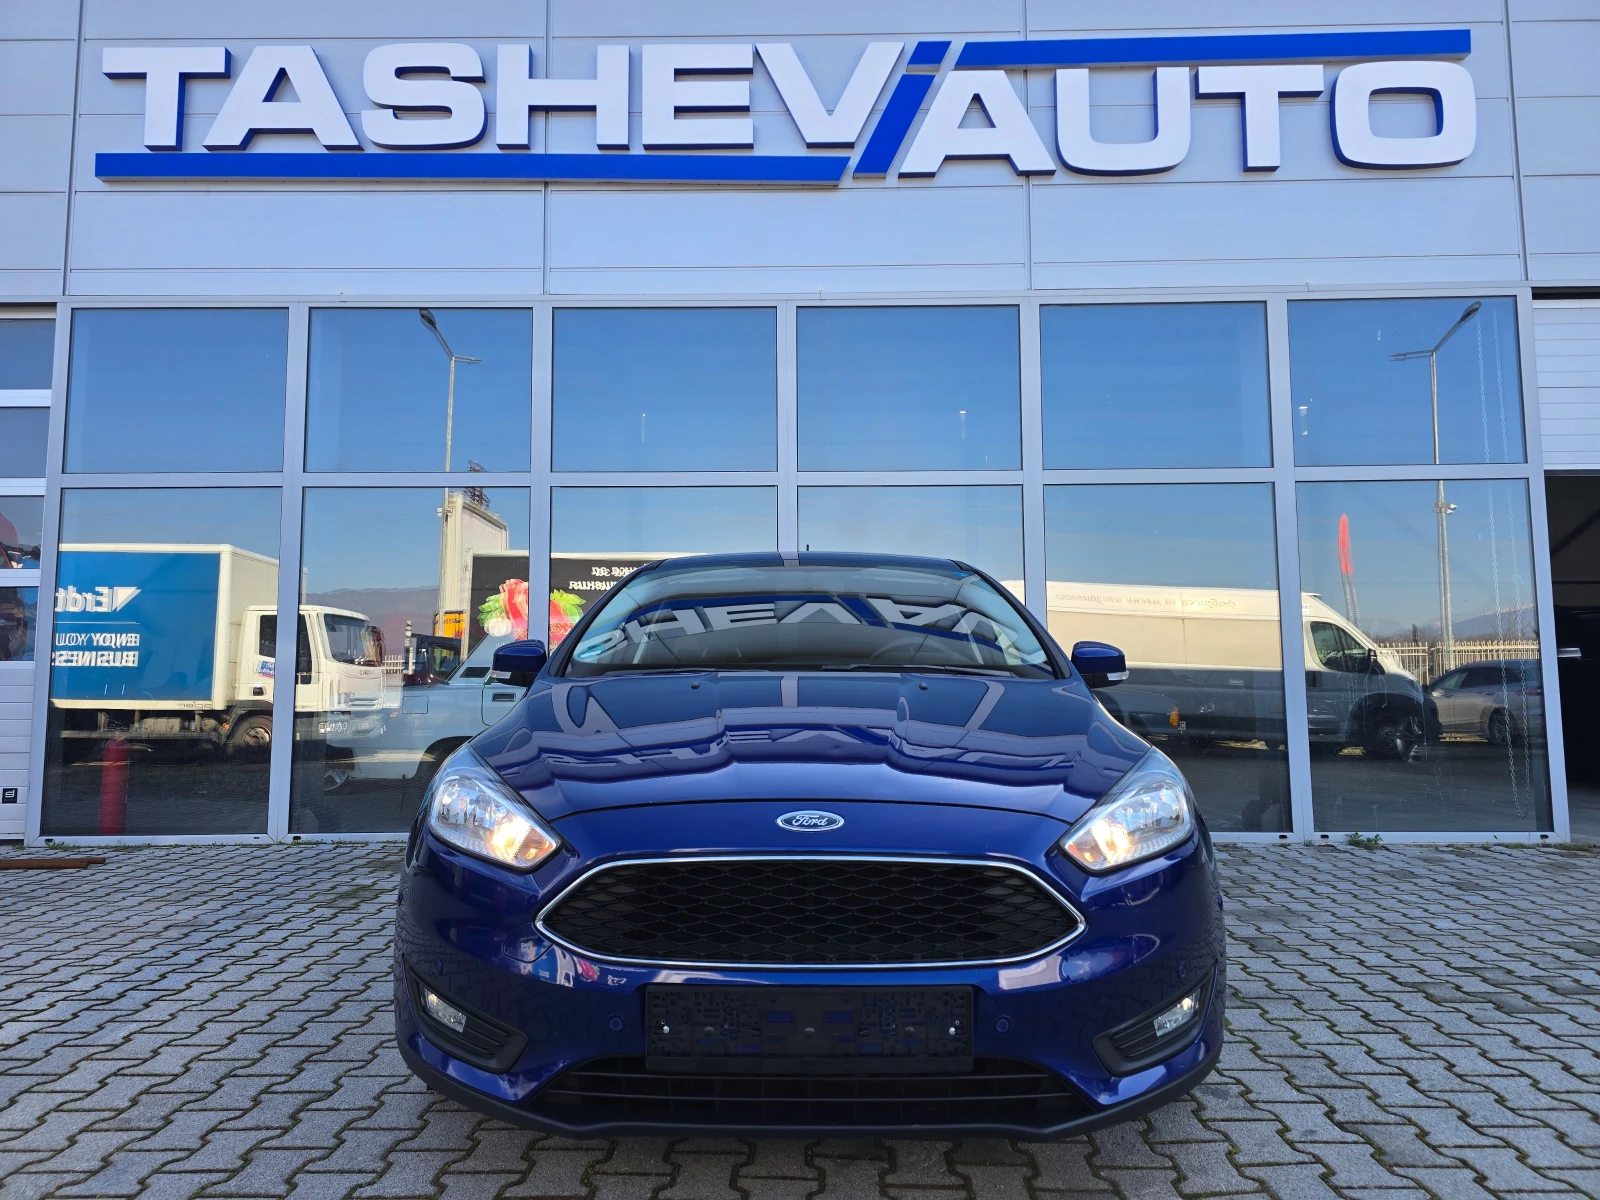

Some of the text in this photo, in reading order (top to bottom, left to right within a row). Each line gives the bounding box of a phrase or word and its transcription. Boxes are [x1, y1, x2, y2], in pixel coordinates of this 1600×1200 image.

[101, 42, 1478, 177] TASHEV AUTO
[791, 814, 829, 826] Ford
